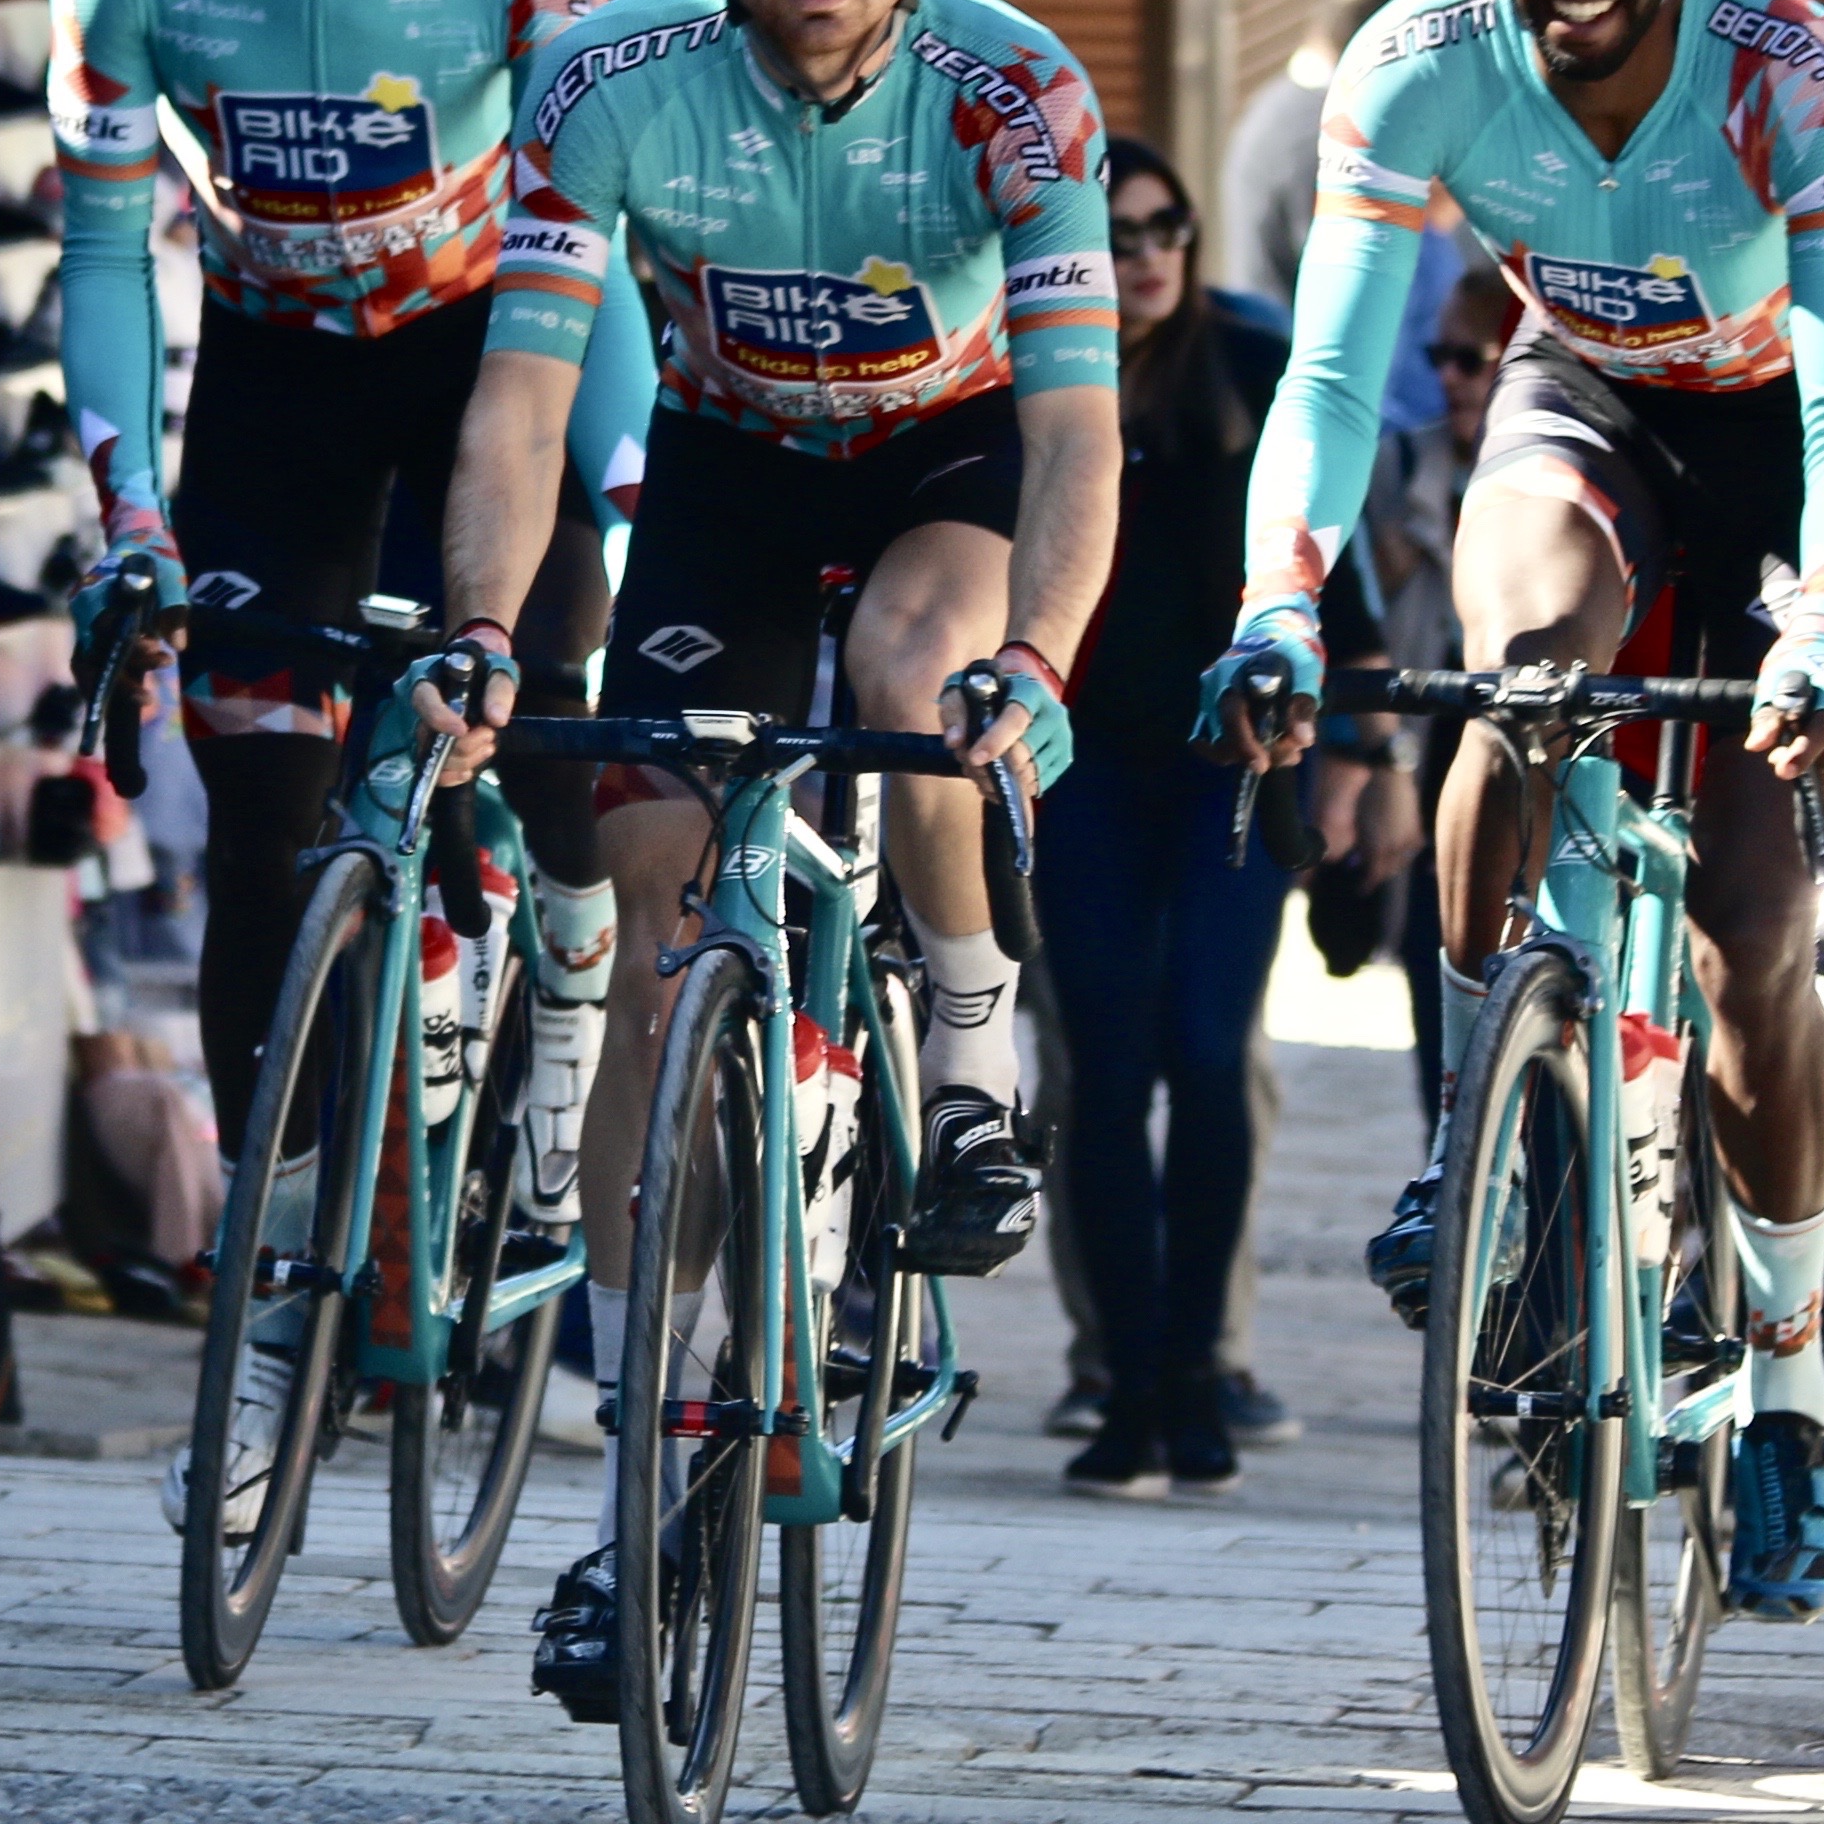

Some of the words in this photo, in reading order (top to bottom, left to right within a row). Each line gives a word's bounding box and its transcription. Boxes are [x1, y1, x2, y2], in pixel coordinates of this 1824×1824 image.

[534, 10, 727, 147] BENOTTI
[910, 28, 1062, 182] BENOTTI
[242, 143, 350, 182] AID
[1005, 261, 1094, 296] antic
[1646, 323, 1701, 345] help
[736, 347, 811, 376] Ride
[857, 348, 930, 377] help
